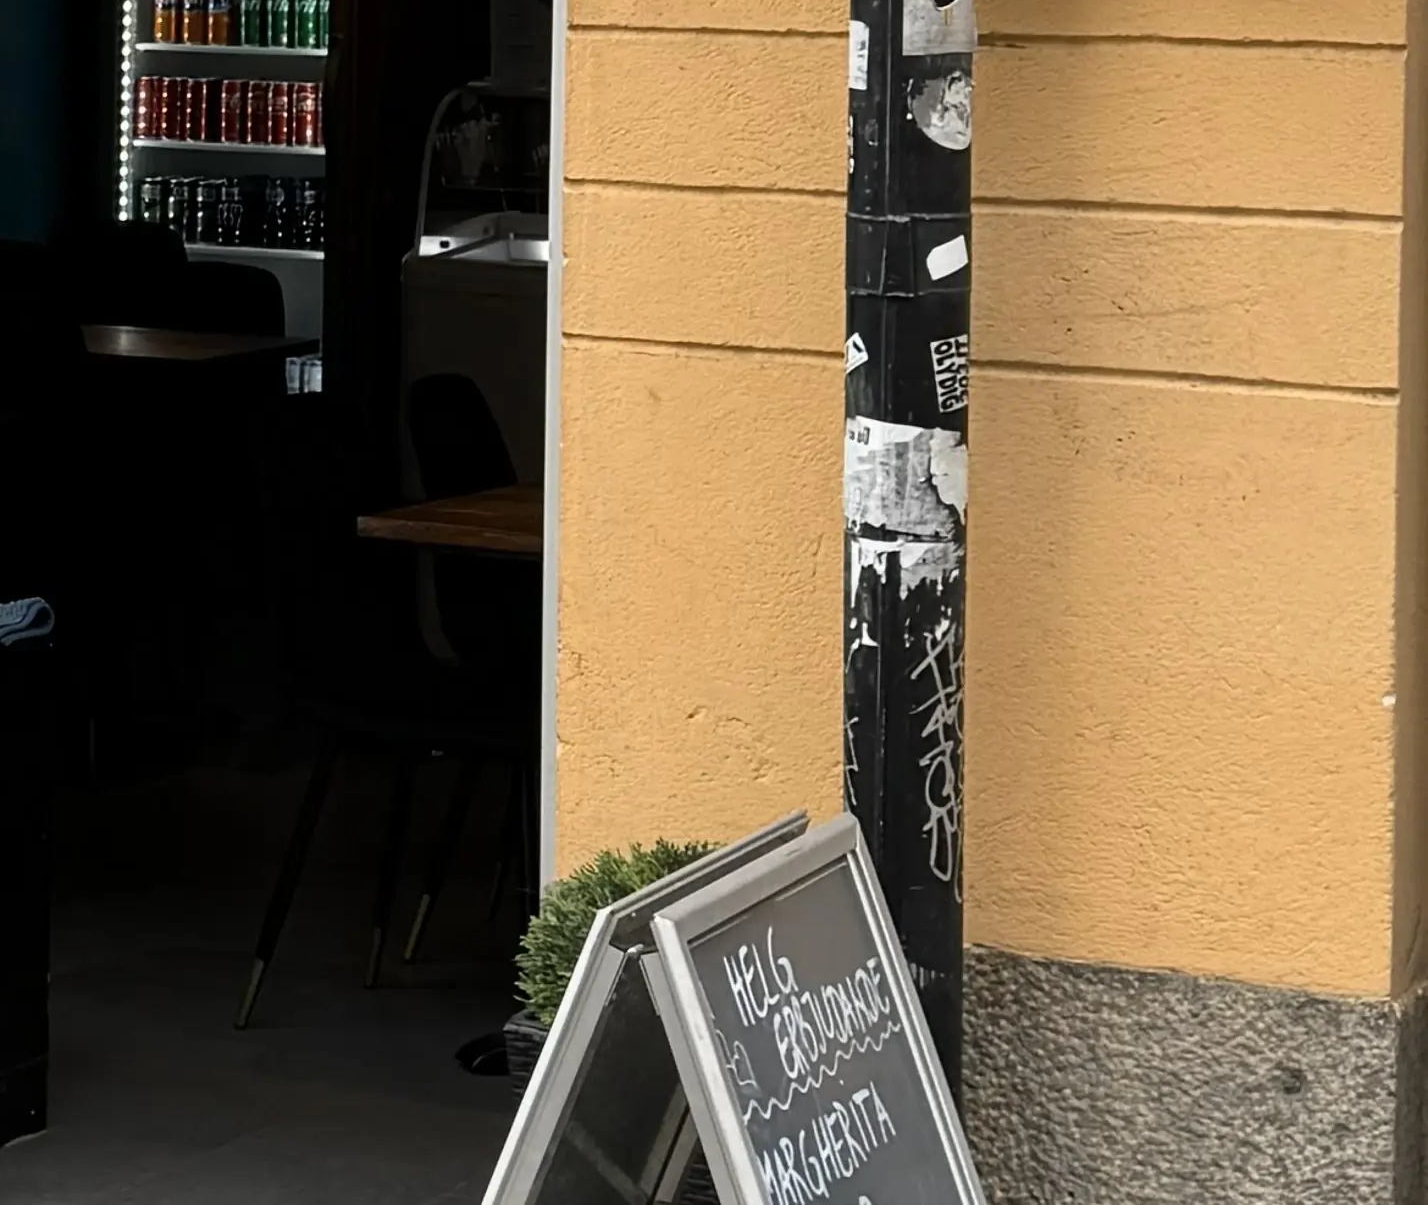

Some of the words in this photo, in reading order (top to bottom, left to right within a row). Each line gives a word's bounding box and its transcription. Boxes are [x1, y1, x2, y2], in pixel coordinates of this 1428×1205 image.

[933, 340, 961, 411] OLYDIG
[723, 926, 800, 1027] HELG
[772, 957, 890, 1080] ERBJUDANDE
[756, 1081, 897, 1205] MARGHERITA
